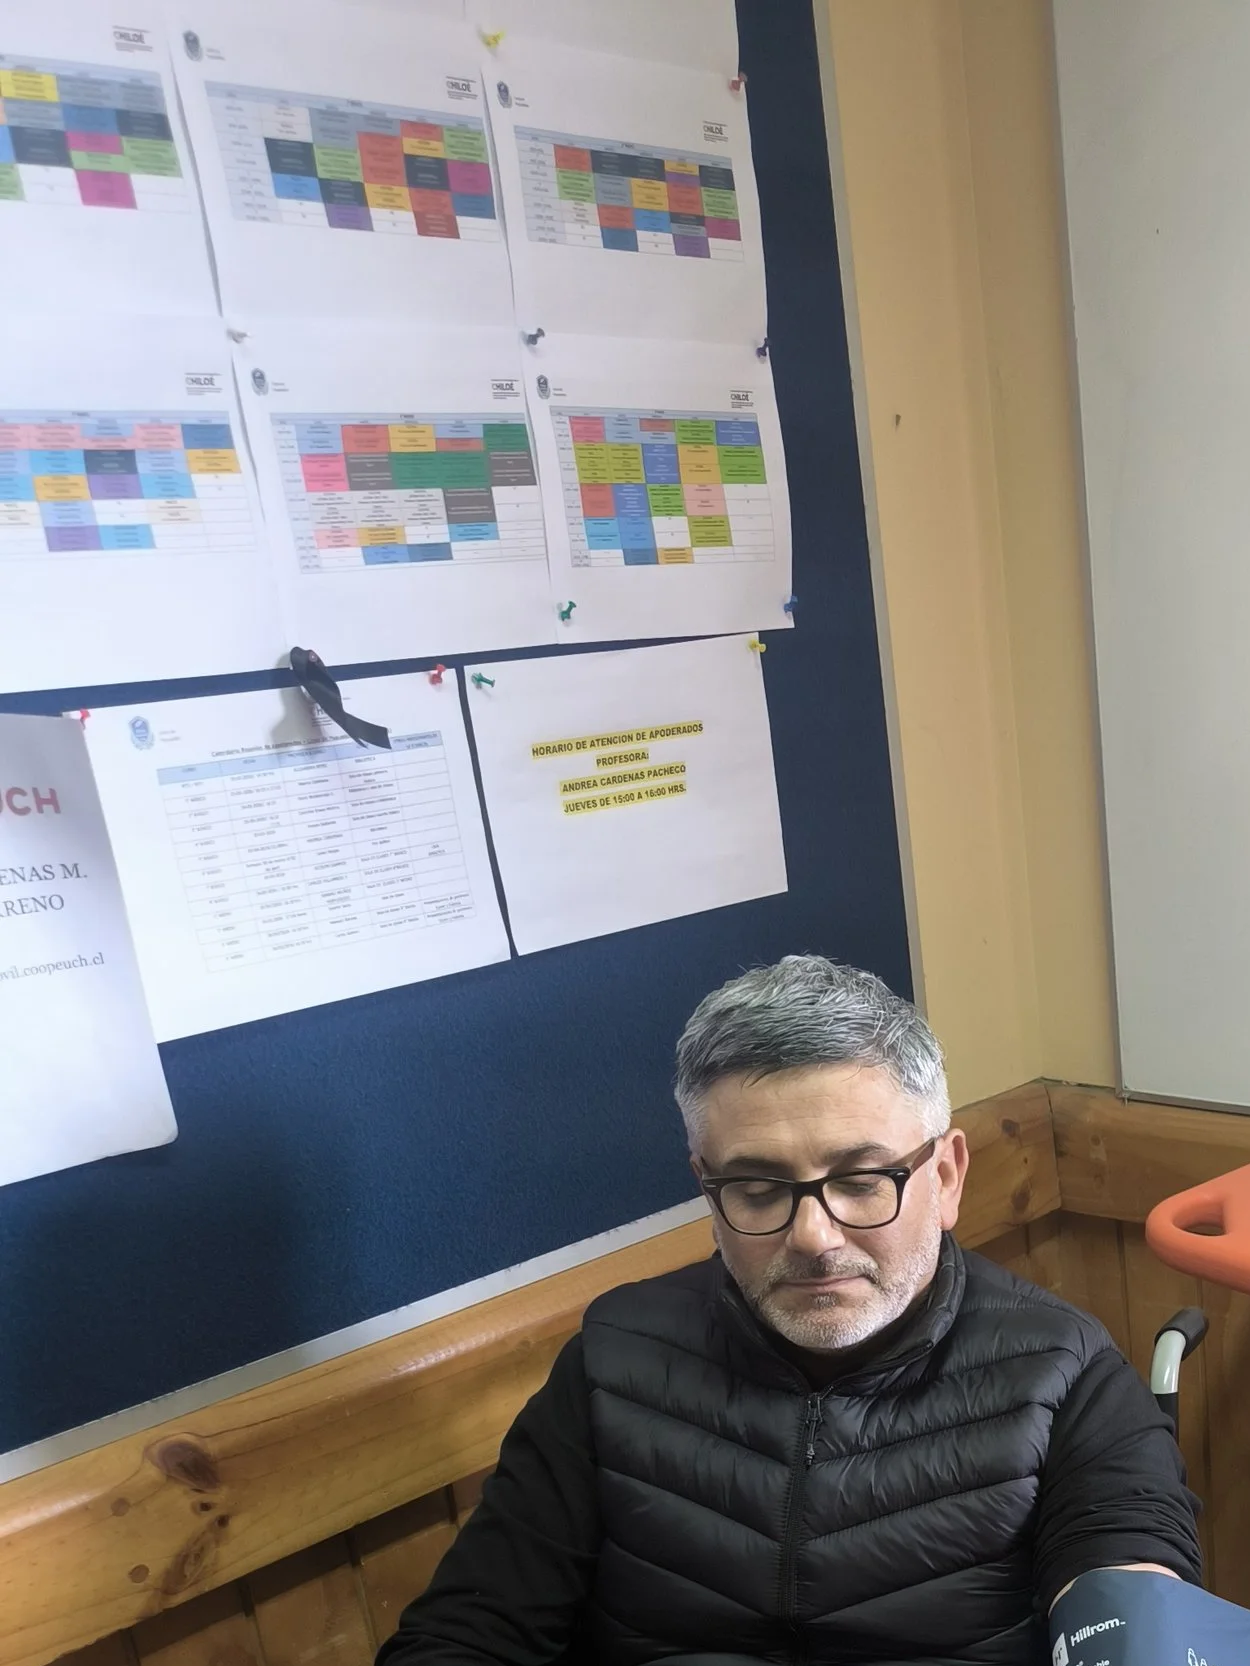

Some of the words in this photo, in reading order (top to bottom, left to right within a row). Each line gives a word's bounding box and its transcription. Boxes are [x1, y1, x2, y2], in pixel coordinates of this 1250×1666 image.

[532, 742, 573, 757] HORARIO
[576, 740, 587, 750] DE
[590, 733, 633, 748] ATENCION
[636, 732, 646, 741] DE
[649, 723, 703, 739] APODERADOS
[596, 751, 649, 768] PROFESORA:
[562, 779, 598, 793] ANDREA
[600, 771, 645, 787] CARDENAS
[648, 764, 686, 778] PACHECO
[0, 786, 62, 817] CH
[564, 799, 597, 813] JUEVES
[600, 797, 611, 807] DE
[613, 793, 635, 805] 15:00
[637, 791, 643, 800] A
[645, 787, 666, 798] 16:00
[668, 783, 686, 794] HRS.
[60, 862, 88, 880] M.
[0, 893, 65, 917] RENO
